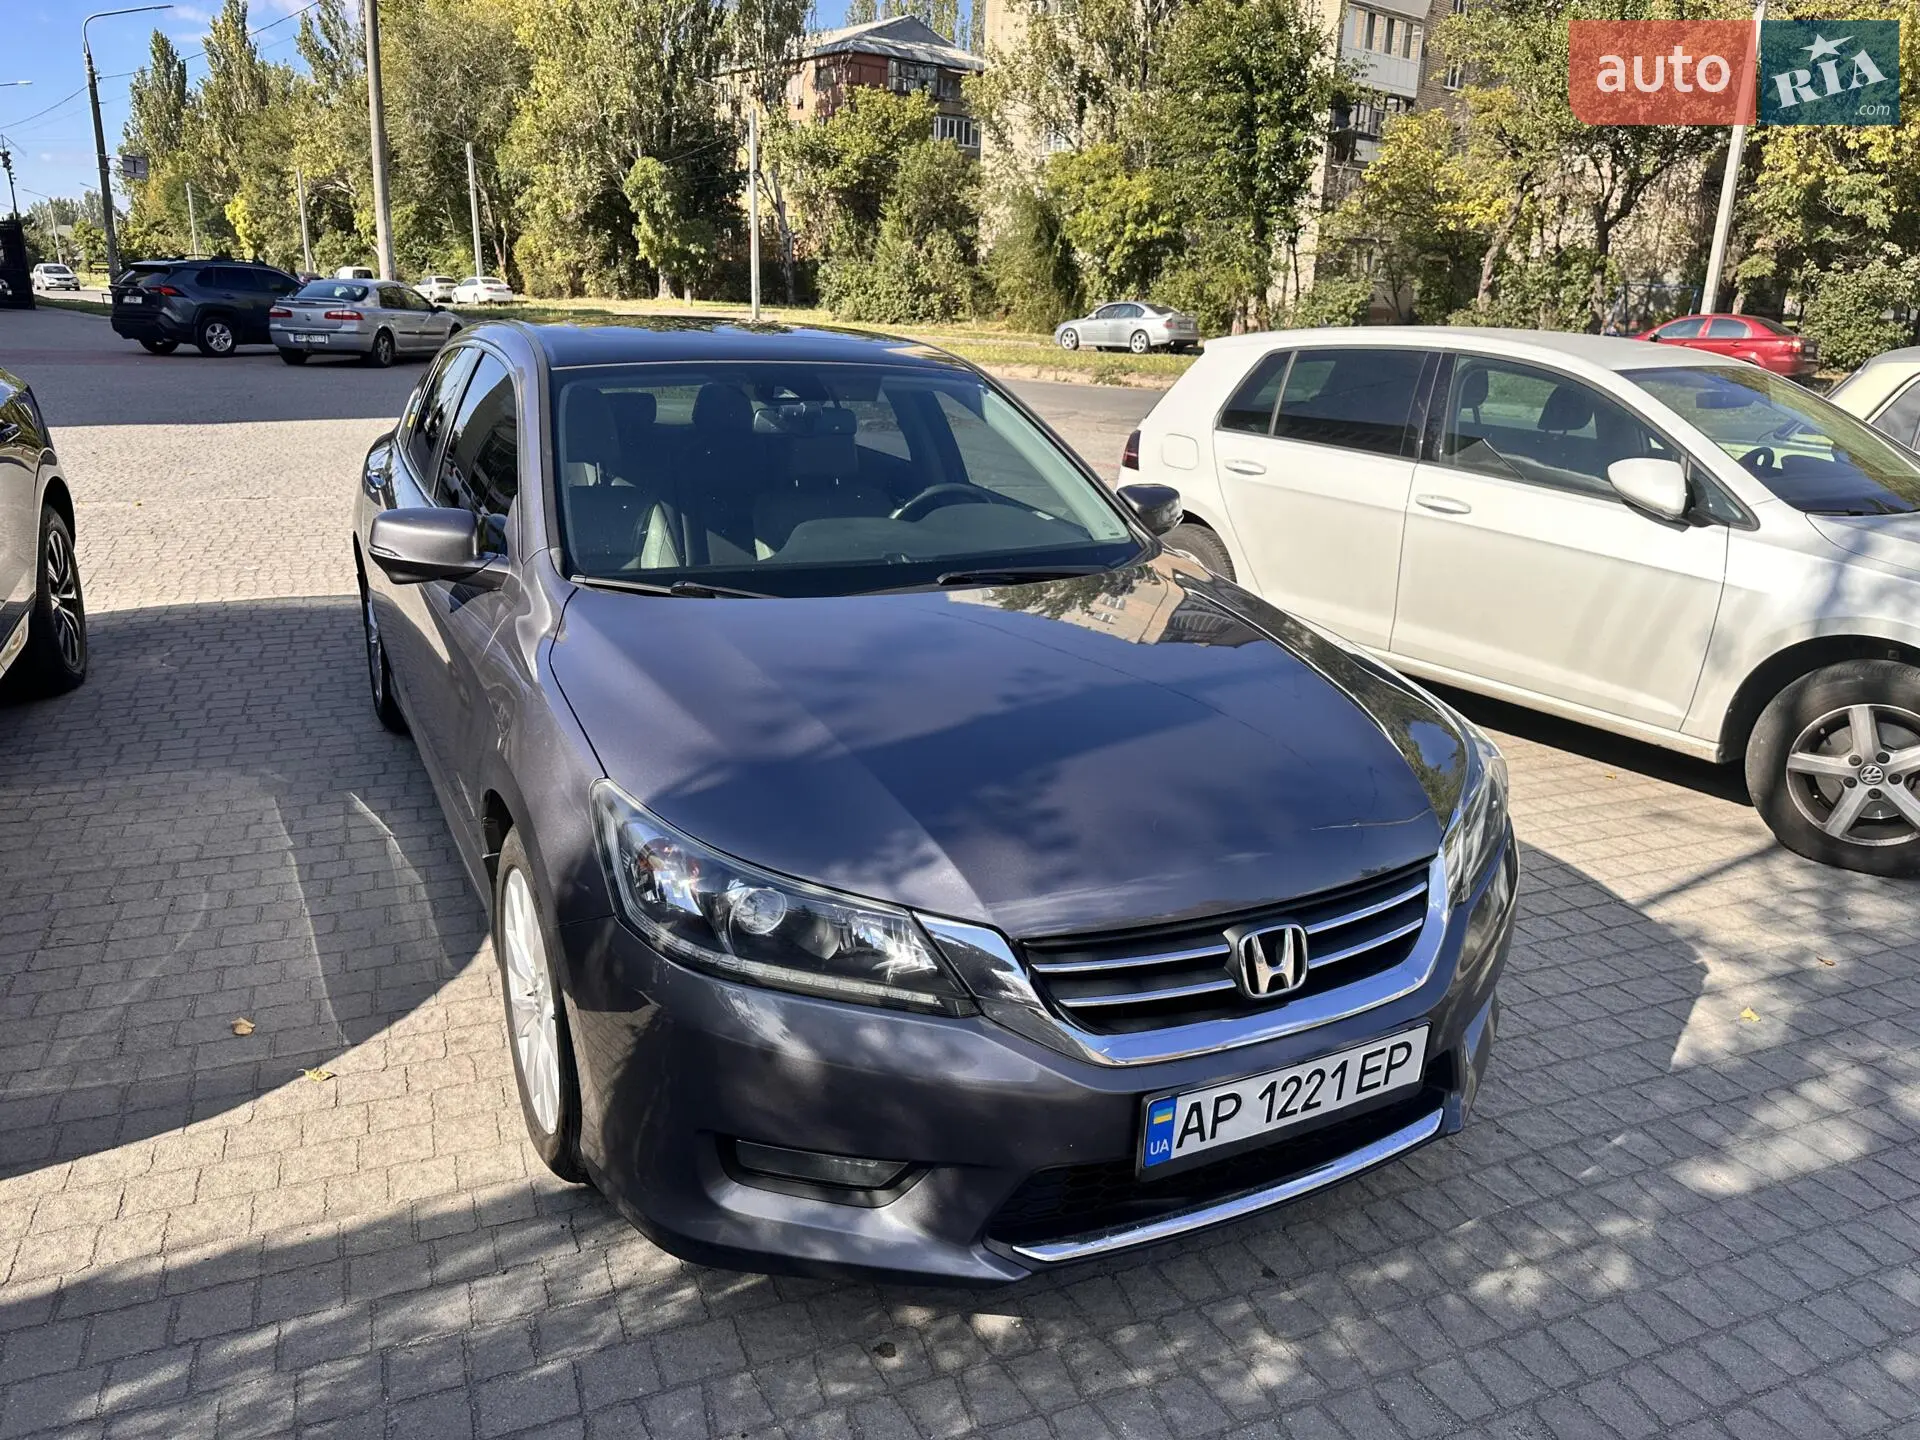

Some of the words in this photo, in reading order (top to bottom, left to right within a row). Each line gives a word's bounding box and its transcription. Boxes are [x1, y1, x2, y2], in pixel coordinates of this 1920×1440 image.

[1176, 1092, 1242, 1150] AP
[1258, 1059, 1348, 1124] 1221
[1356, 1041, 1413, 1095] EP
[1150, 1138, 1170, 1156] UA
